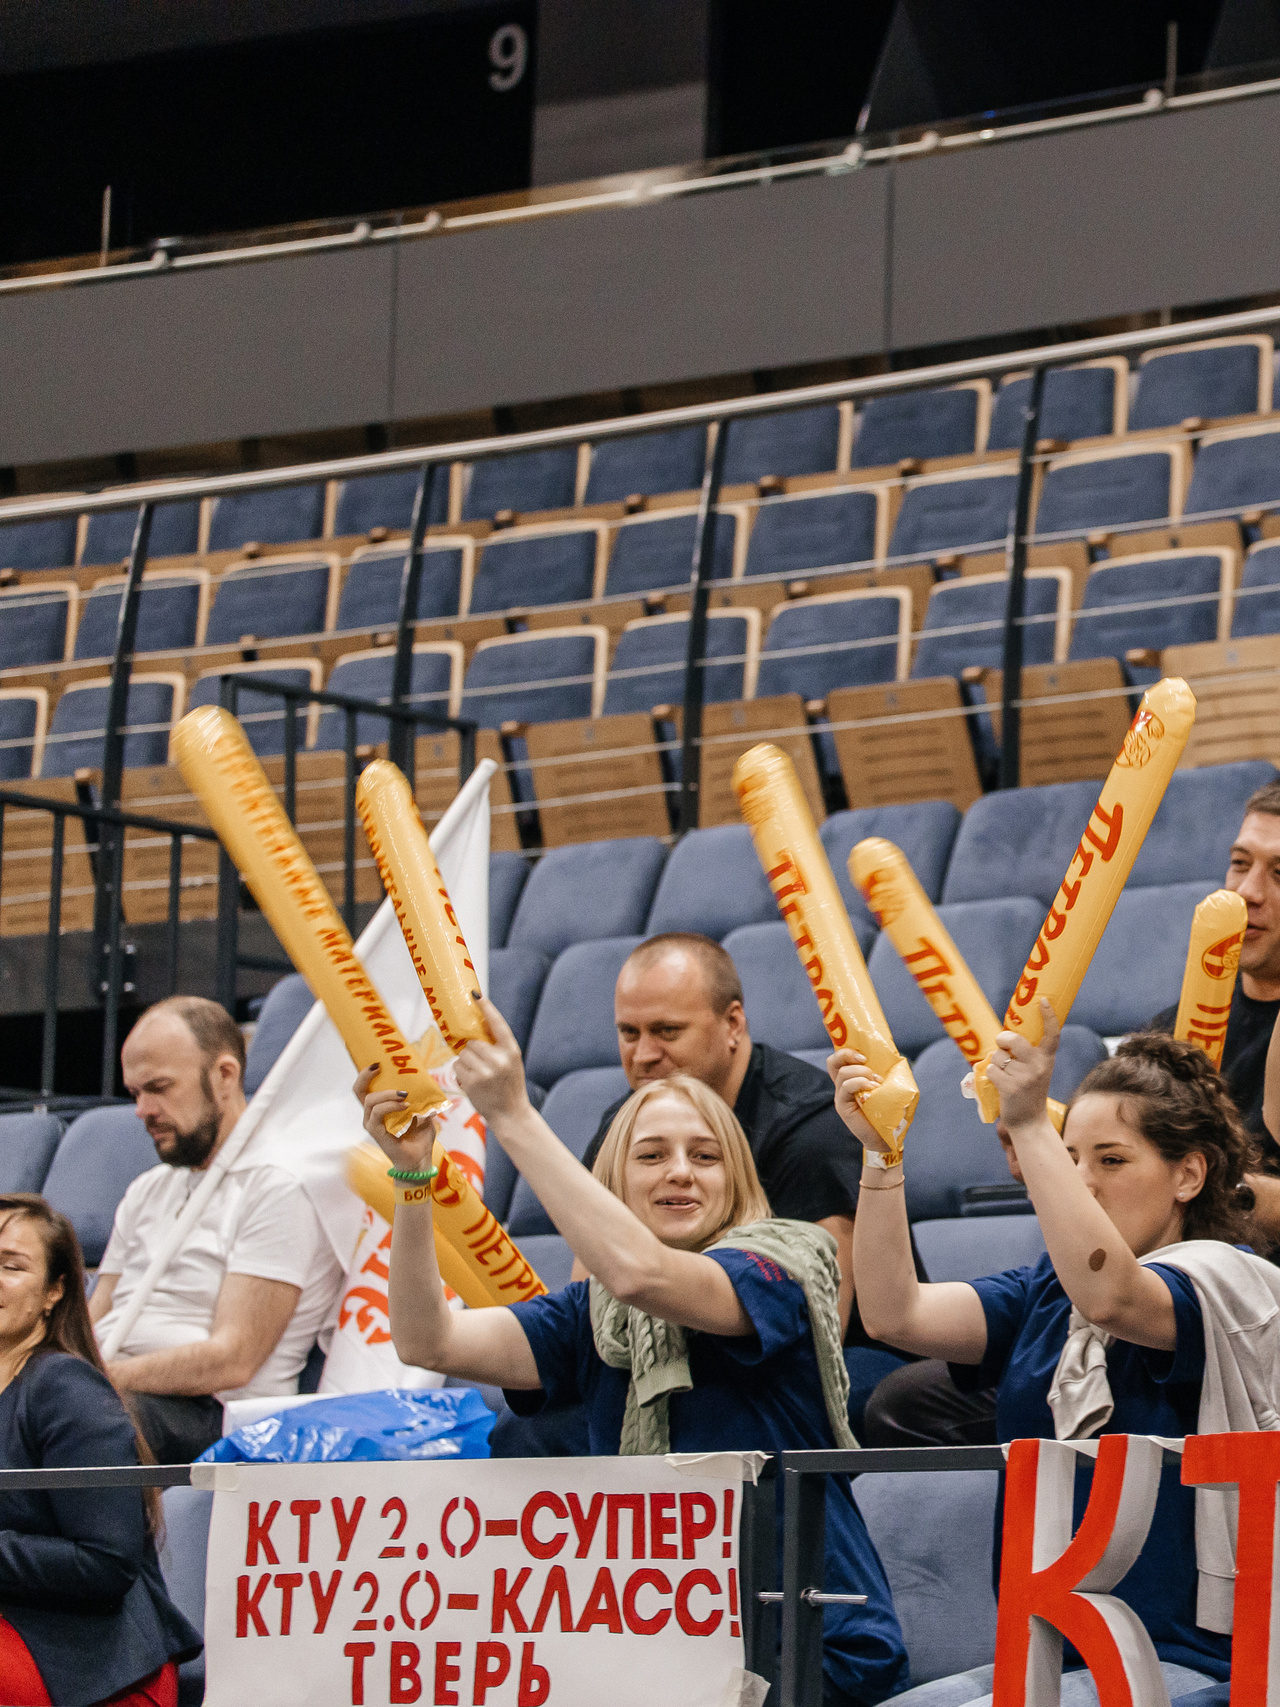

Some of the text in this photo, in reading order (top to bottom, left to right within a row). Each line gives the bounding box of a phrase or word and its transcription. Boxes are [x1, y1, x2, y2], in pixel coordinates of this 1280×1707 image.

[488, 23, 527, 91] 9
[316, 927, 418, 1075] МАТЕРИАЛЫ
[245, 1495, 365, 1566] КТУ
[344, 1640, 551, 1707] ТВЕРЬ
